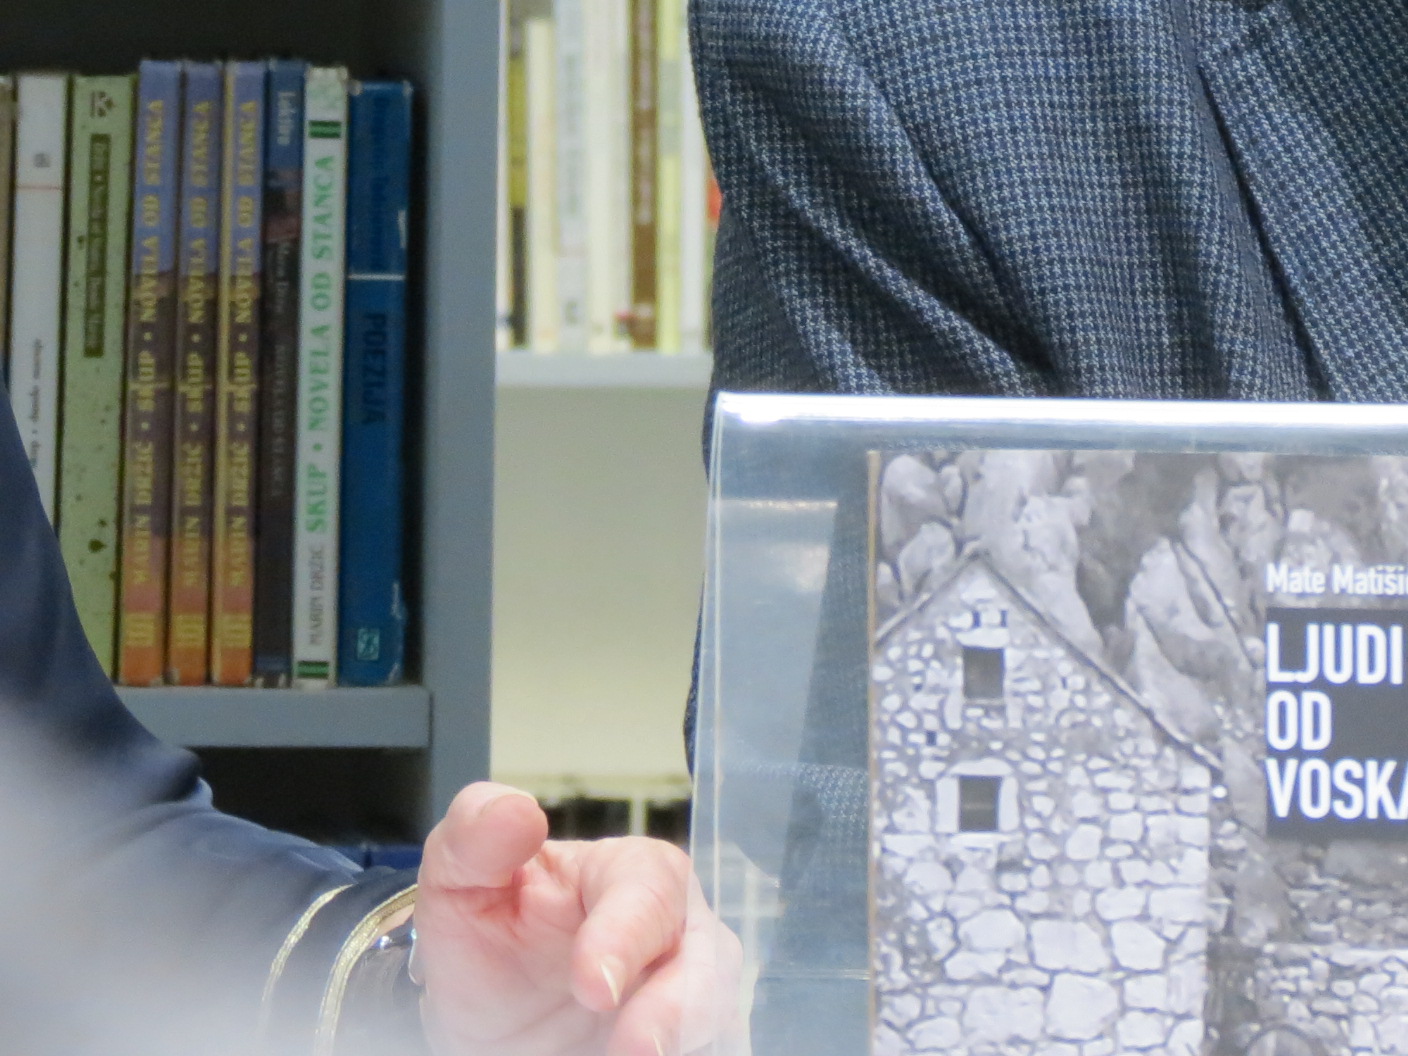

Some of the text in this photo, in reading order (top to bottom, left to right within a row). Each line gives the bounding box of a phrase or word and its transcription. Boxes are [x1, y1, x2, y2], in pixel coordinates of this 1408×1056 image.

[143, 99, 164, 186] STANCA
[191, 99, 210, 186] STANCA
[237, 99, 258, 186] STANCA
[142, 195, 161, 228] OD
[190, 195, 209, 228] OD
[236, 195, 255, 228] OD
[312, 155, 334, 259] STANCA
[139, 235, 160, 324] NOVELA
[187, 235, 207, 324] NOVELA
[234, 235, 255, 324] NOVELA
[310, 272, 332, 311] OD
[136, 350, 156, 413] SKUP
[185, 350, 205, 413] SKUP
[233, 350, 251, 413] SKUP
[308, 324, 330, 431] NOVELA
[362, 313, 388, 426] POEZIJA
[306, 463, 327, 534] SKUP
[1266, 563, 1325, 594] Mate
[1266, 622, 1403, 685] LJUDI
[1266, 690, 1332, 751] OD
